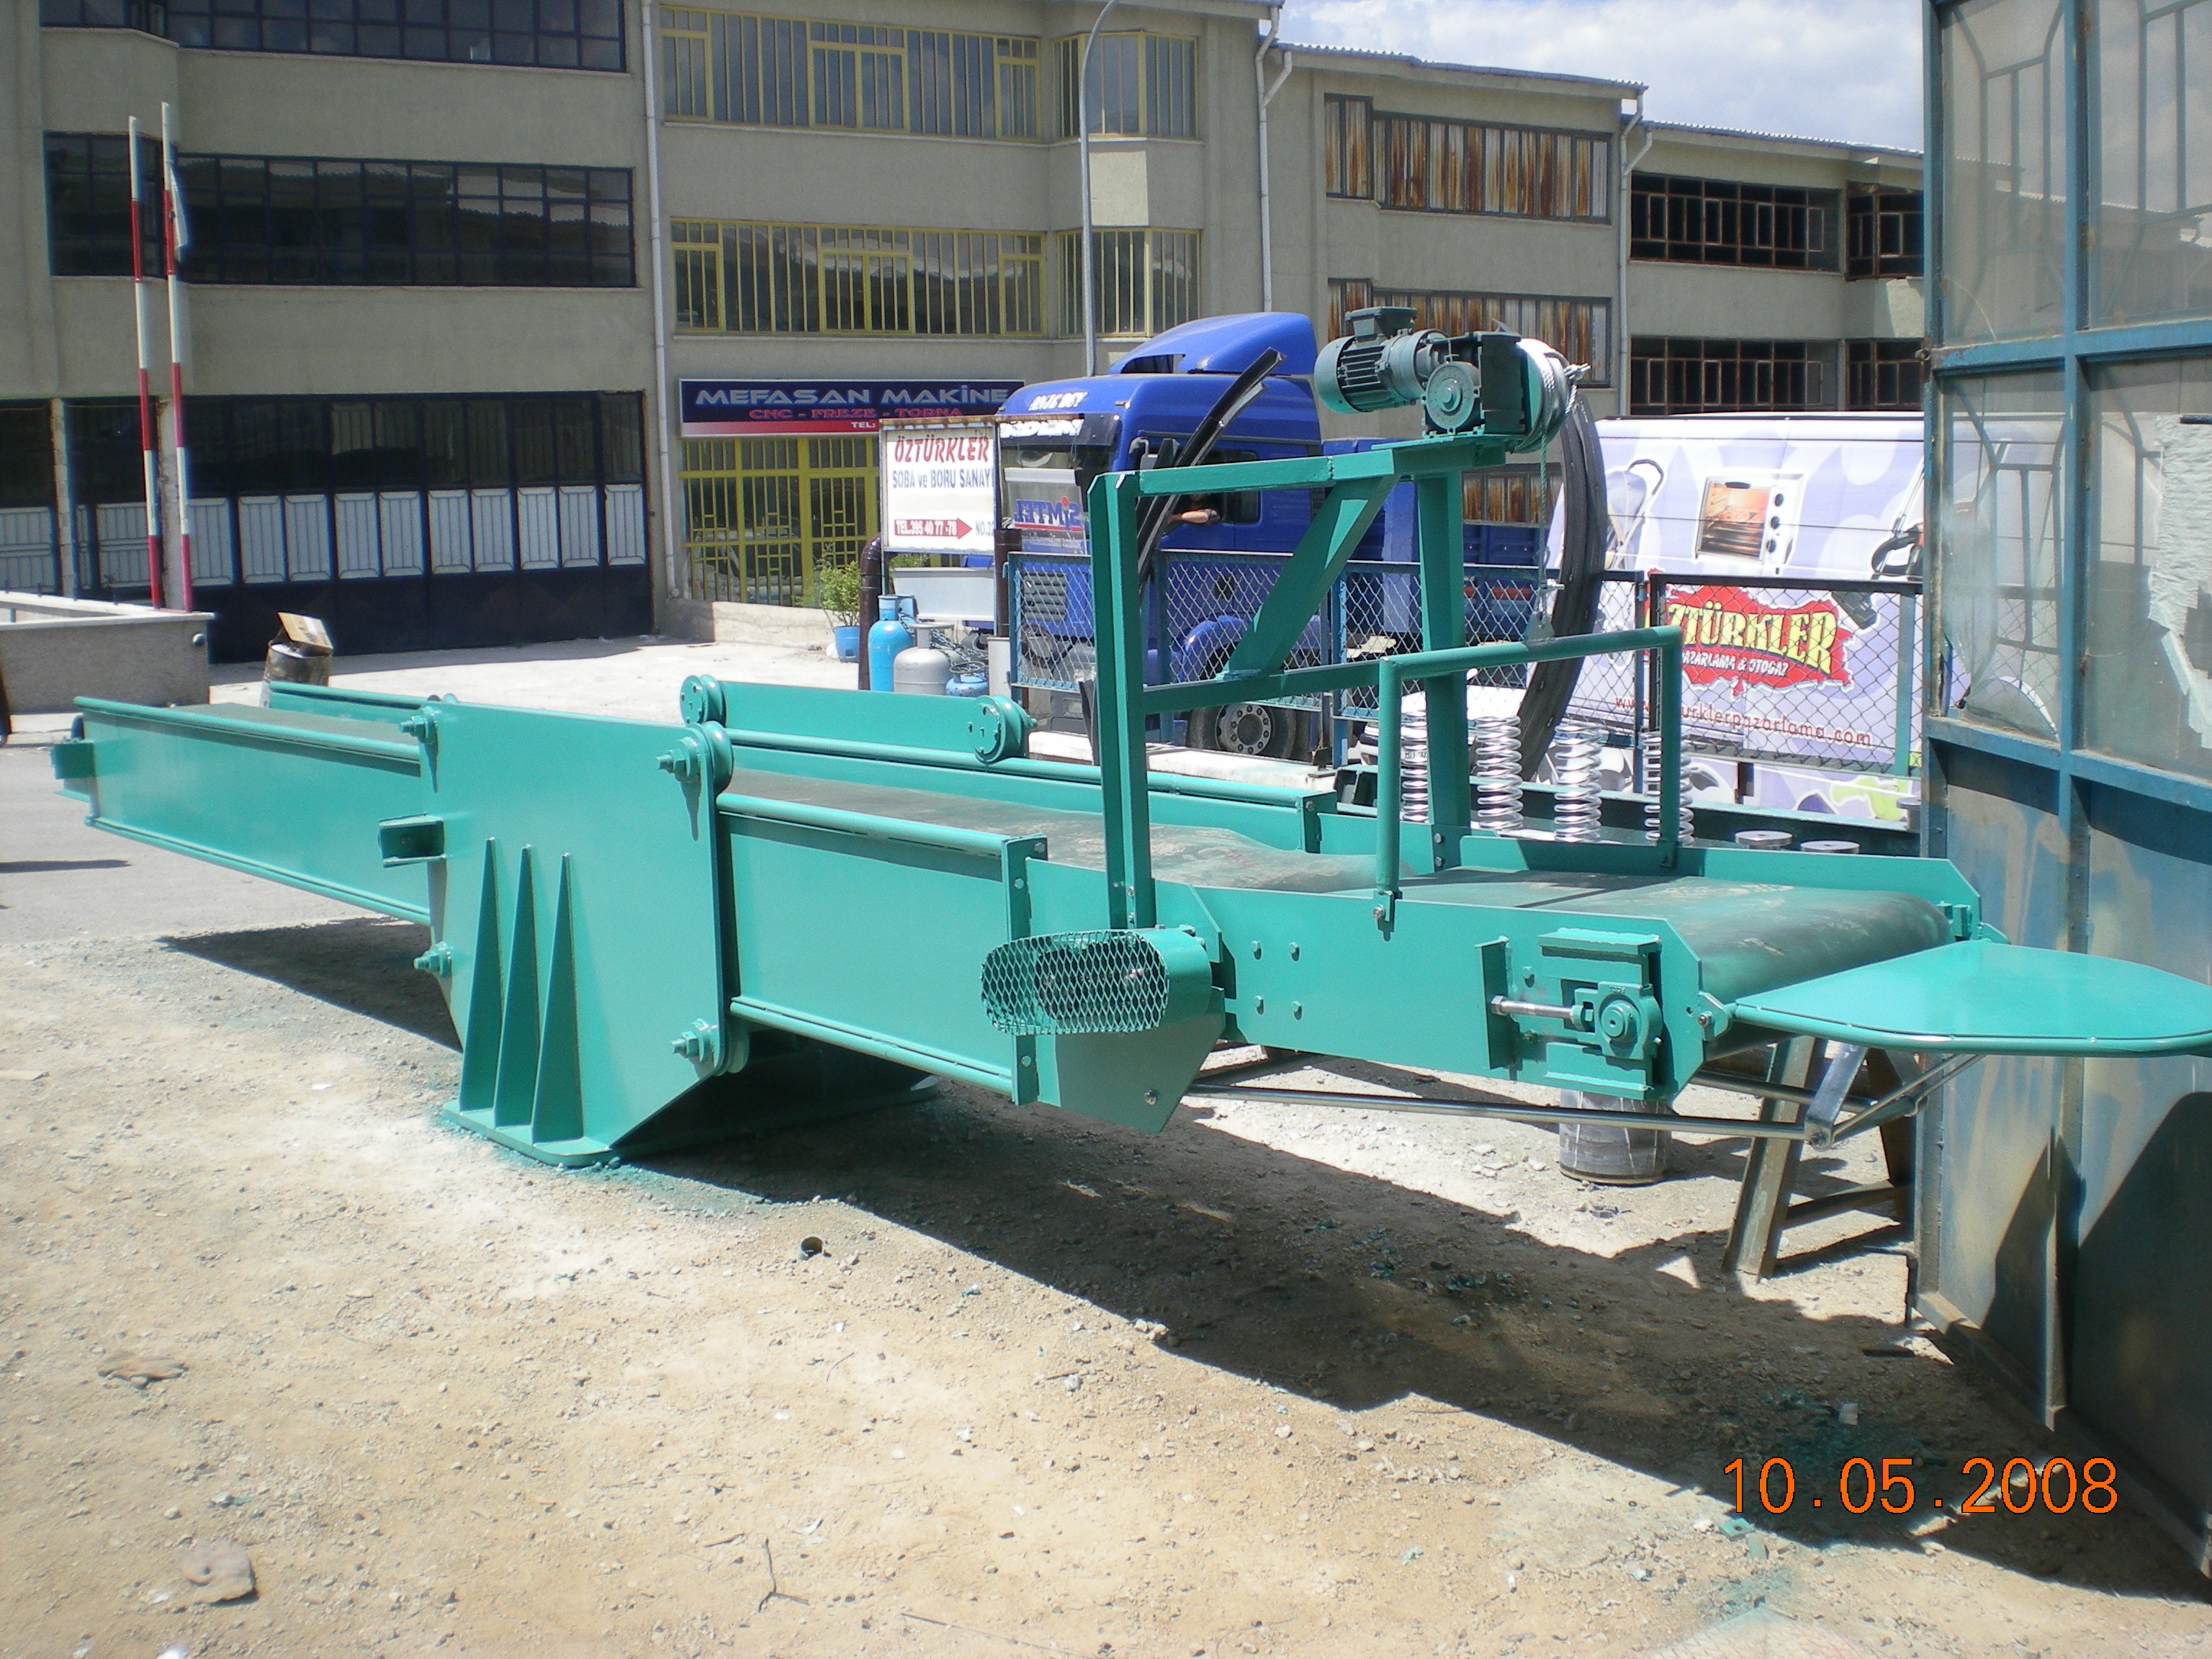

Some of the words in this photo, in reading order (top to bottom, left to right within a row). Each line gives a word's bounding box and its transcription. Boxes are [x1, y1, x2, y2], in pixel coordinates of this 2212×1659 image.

[696, 390, 870, 405] MEFASAN
[881, 385, 1008, 404] MAKİNE
[749, 409, 793, 419] CNC
[811, 408, 878, 418] FREZE
[895, 408, 963, 418] TORNA
[894, 433, 989, 464] ÖZTÜRKLER
[892, 469, 915, 489] SOBA
[918, 474, 927, 488] ve
[930, 469, 956, 488] BORU
